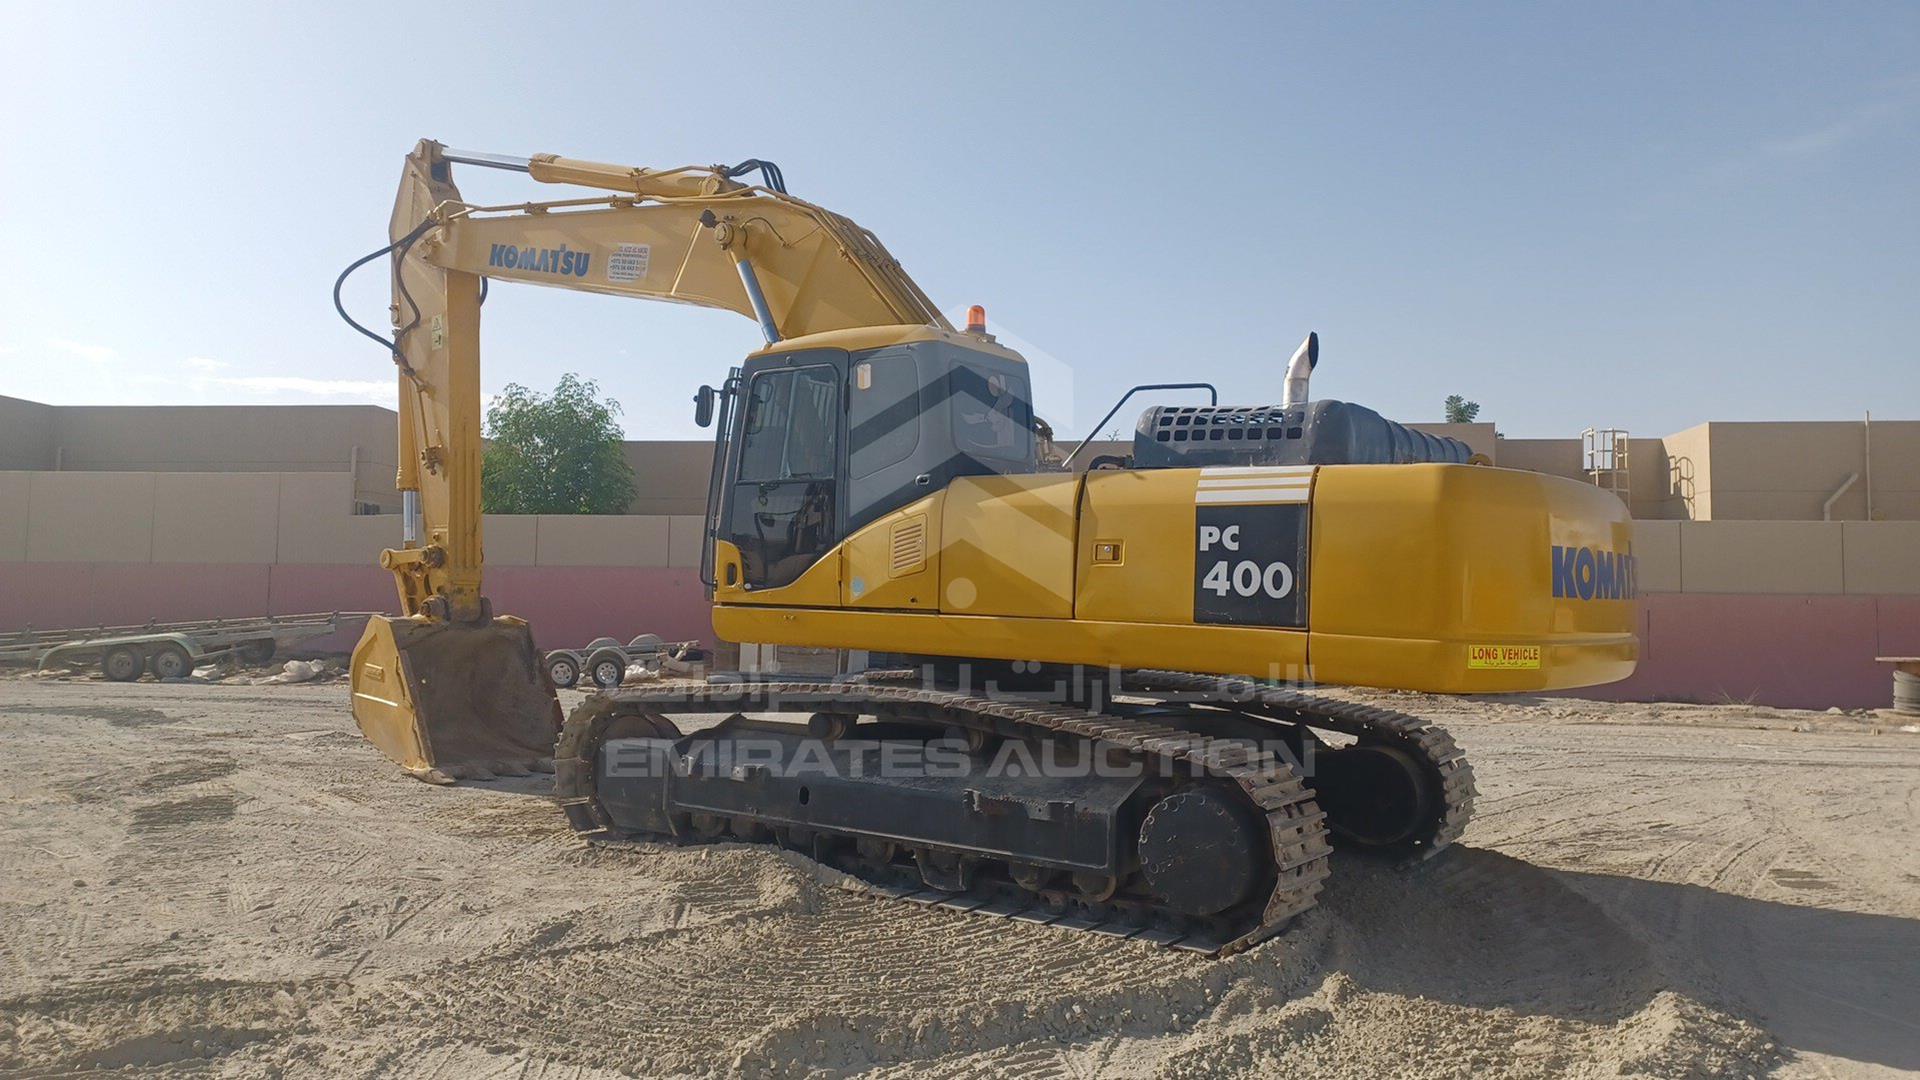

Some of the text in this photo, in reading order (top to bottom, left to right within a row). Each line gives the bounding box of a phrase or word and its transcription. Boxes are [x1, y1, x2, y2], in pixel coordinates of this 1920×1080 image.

[489, 243, 591, 277] KOMATSU
[1200, 525, 1240, 551] PC
[1202, 560, 1293, 599] 400
[1472, 647, 1539, 660] LONG VEHICLE
